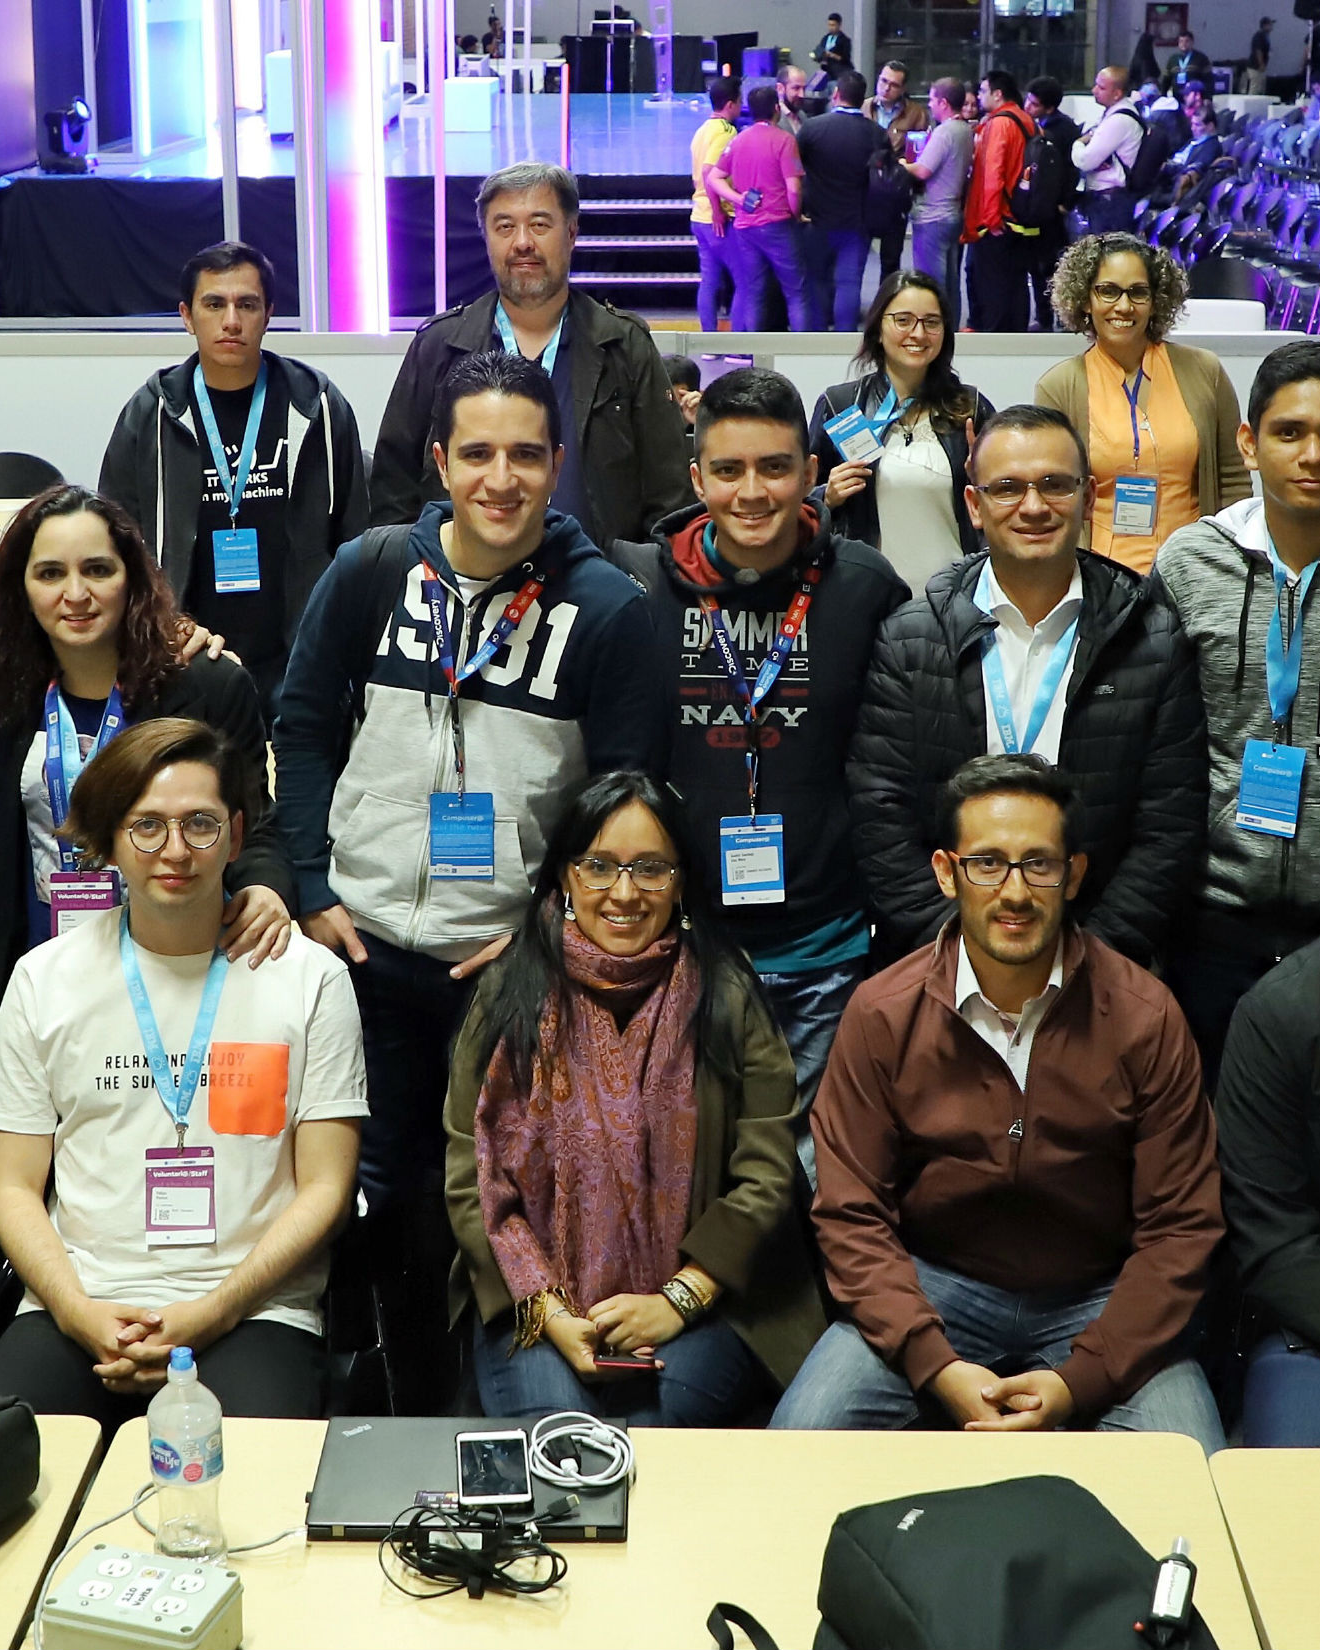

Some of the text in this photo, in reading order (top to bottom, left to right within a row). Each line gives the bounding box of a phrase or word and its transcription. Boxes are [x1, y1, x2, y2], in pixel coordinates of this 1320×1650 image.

[207, 475, 220, 488] IT
[105, 1055, 150, 1070] RELAX
[95, 1075, 120, 1091] THE
[200, 1073, 256, 1088] BREEZE
